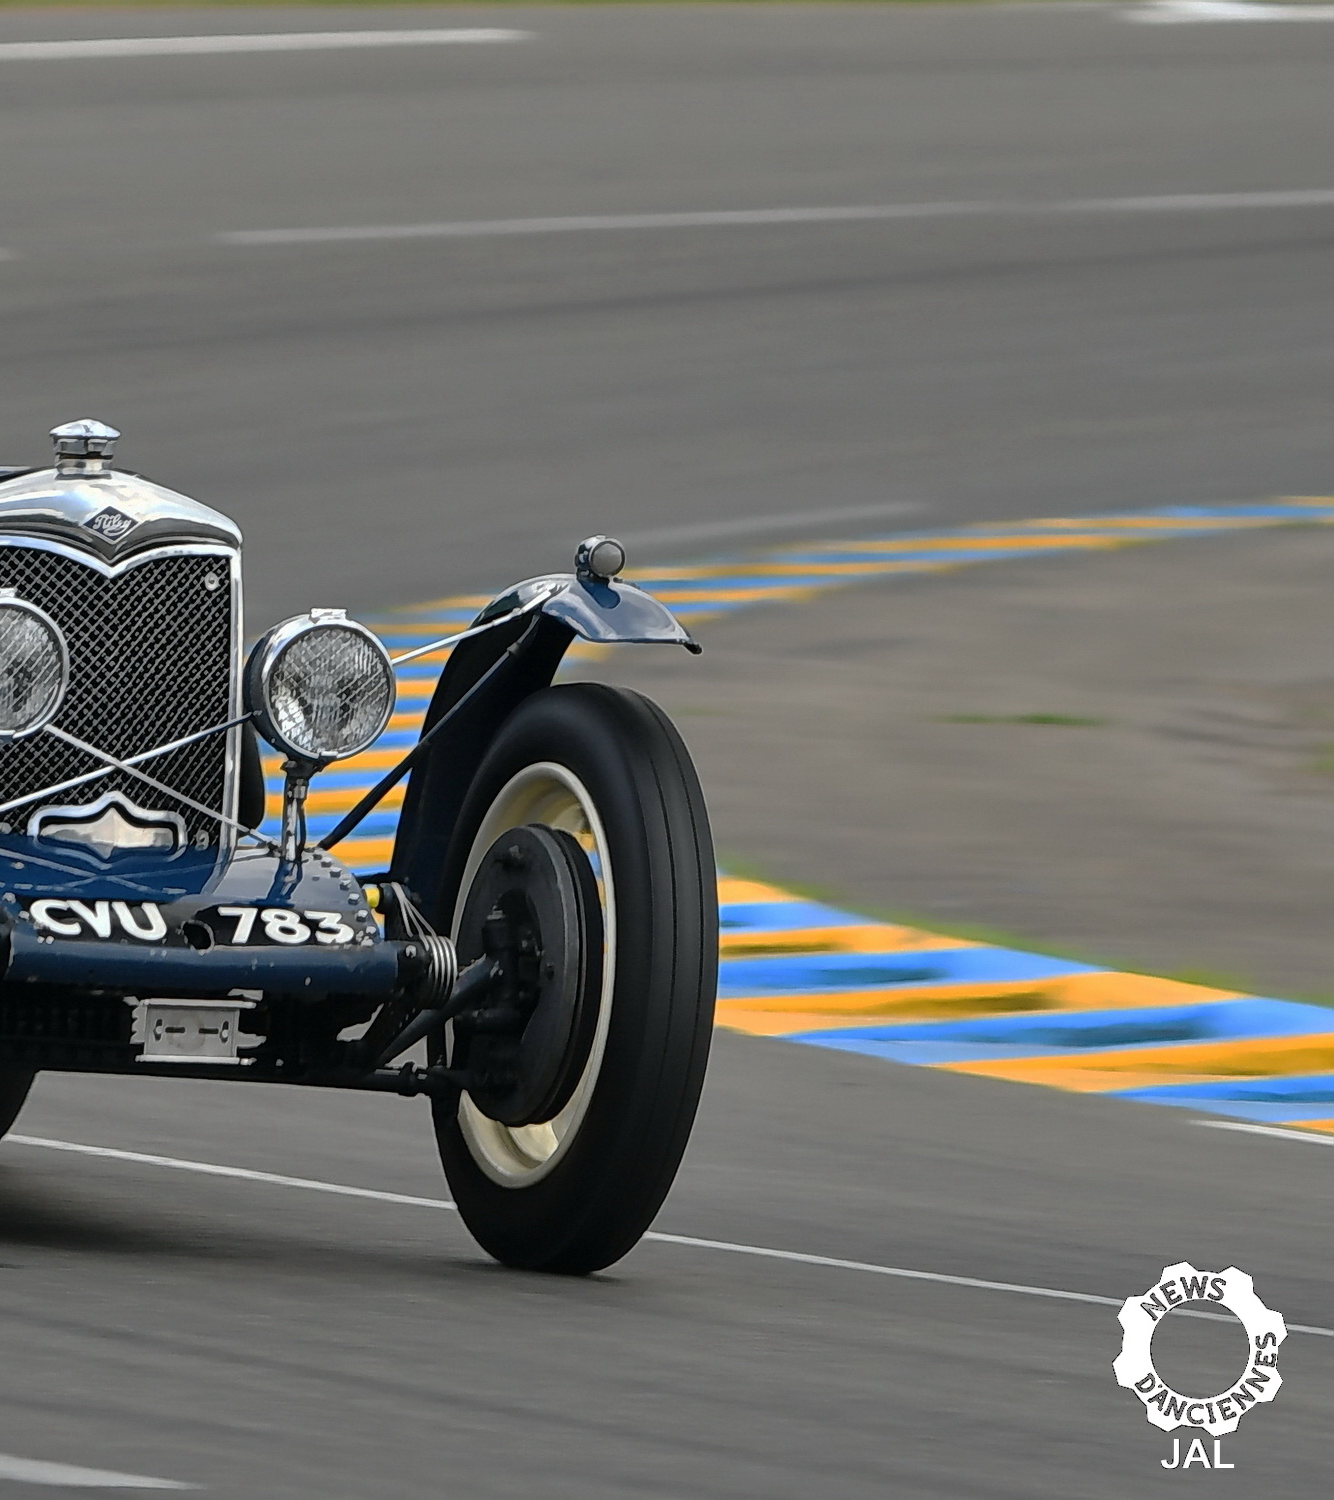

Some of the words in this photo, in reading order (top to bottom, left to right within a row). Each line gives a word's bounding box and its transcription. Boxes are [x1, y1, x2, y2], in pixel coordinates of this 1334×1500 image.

[92, 513, 132, 537] Riley
[29, 899, 168, 941] CVU
[217, 906, 355, 944] 783
